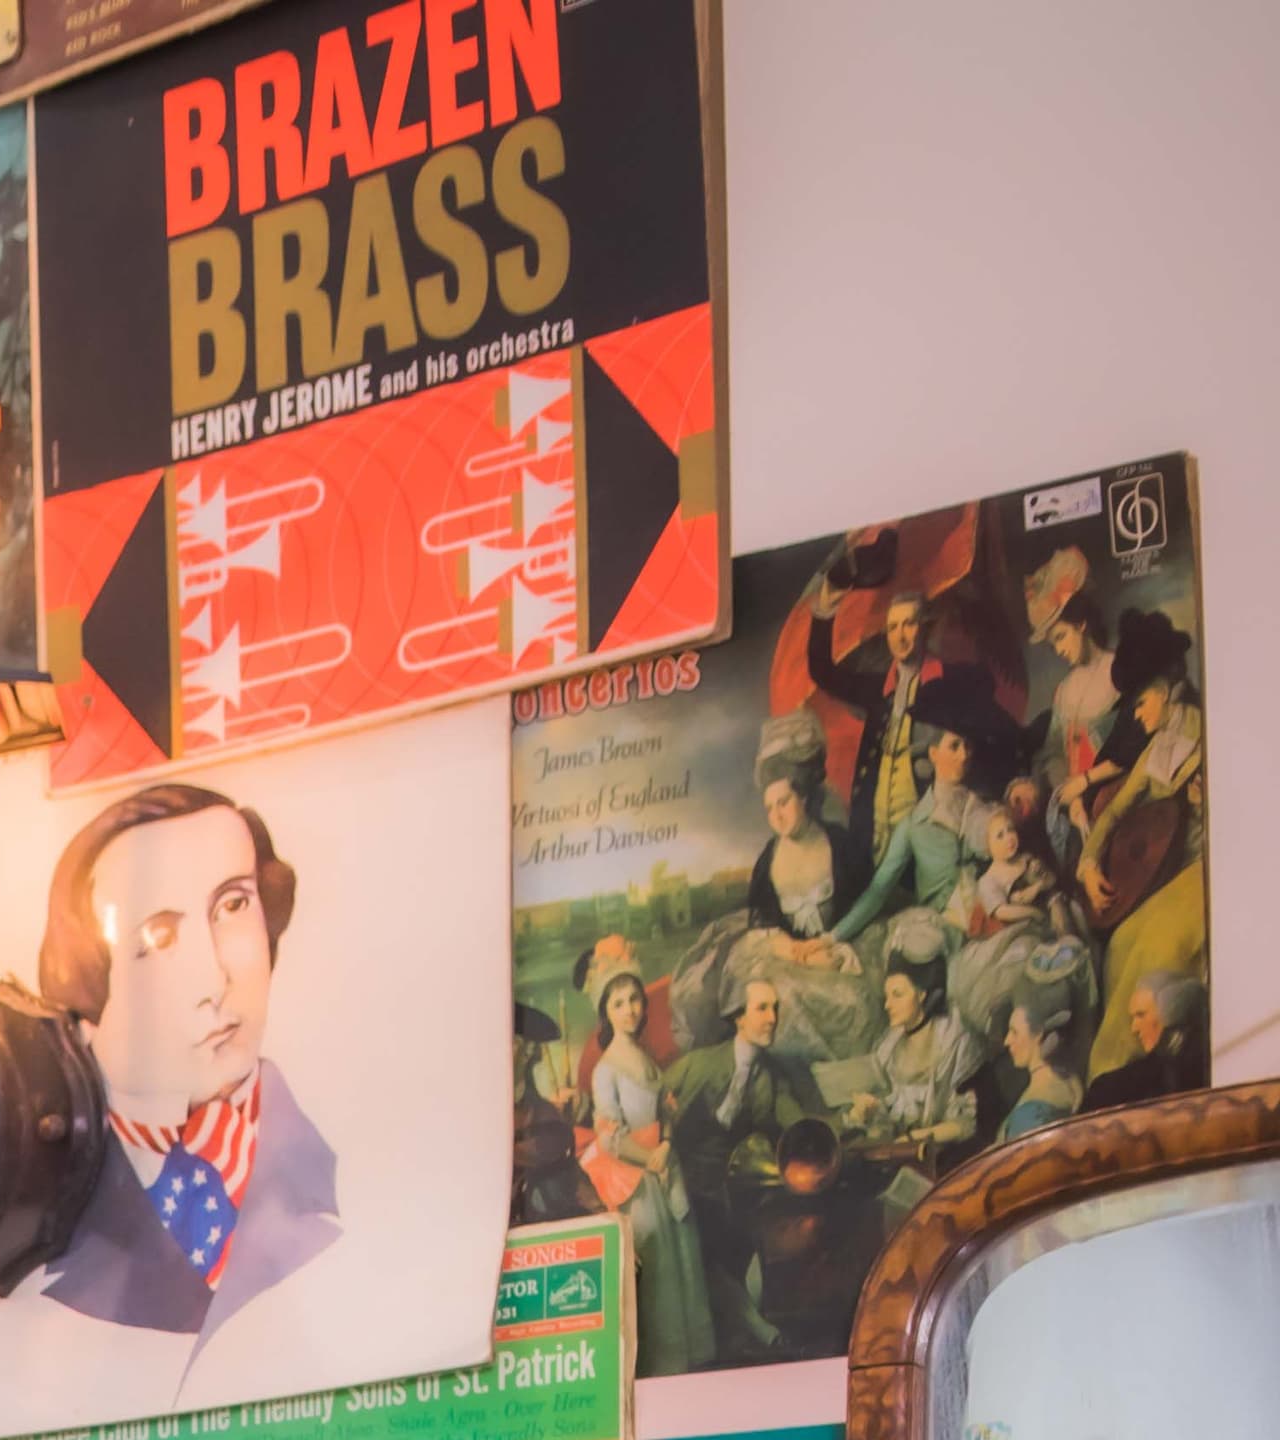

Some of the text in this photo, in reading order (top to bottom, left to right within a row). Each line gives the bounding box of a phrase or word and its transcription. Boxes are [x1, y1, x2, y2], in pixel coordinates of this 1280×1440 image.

[163, 0, 562, 238] BRAZEN
[168, 117, 571, 417] BRASS
[171, 318, 575, 461] HENRY JEROME and his orchestra
[534, 734, 663, 783] James Brown
[585, 784, 604, 823] of
[608, 768, 691, 816] England
[520, 821, 679, 868] Arthur Davison
[511, 1240, 577, 1267] SONGS
[497, 1339, 597, 1391] Patrick
